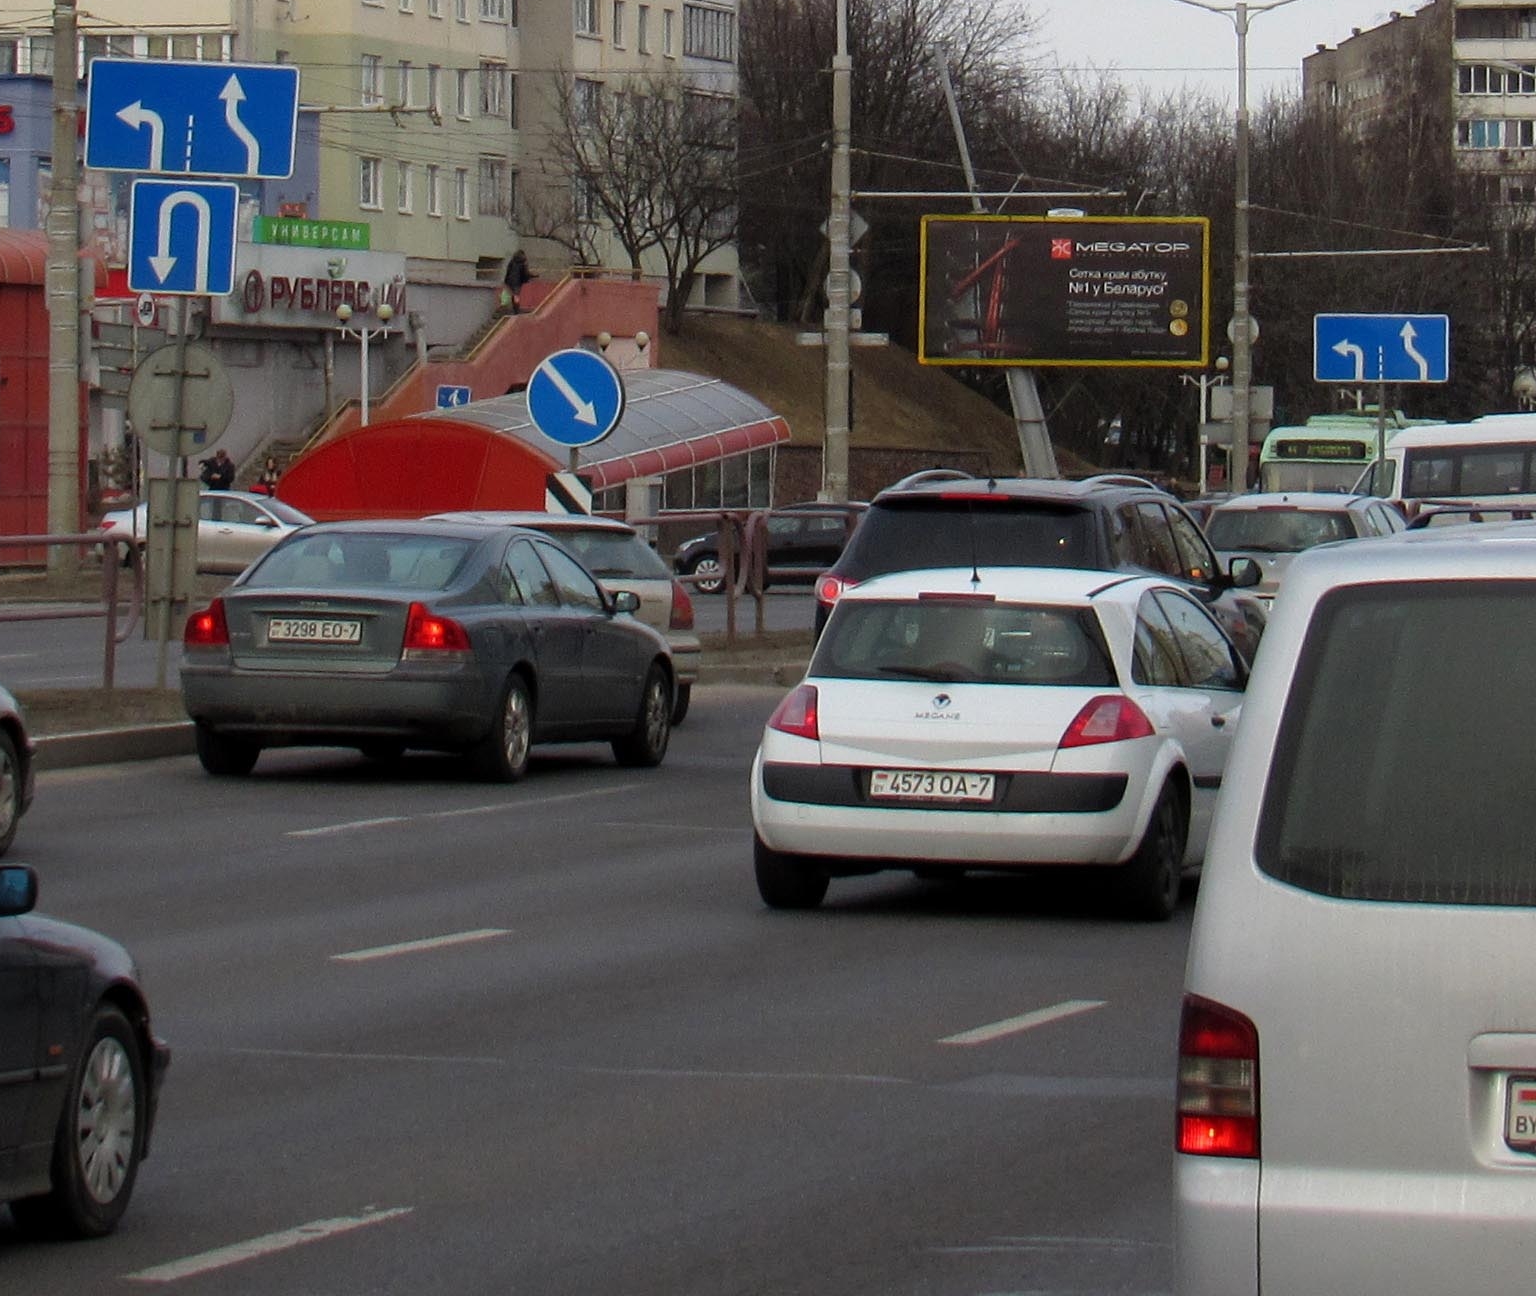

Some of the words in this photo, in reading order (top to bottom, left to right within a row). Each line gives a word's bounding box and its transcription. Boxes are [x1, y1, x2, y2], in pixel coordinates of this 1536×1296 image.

[270, 222, 363, 243] УНИВЕРСАМ
[1075, 241, 1192, 253] MEGATOP
[1068, 268, 1102, 280] Сетка
[1103, 271, 1130, 282] крам
[1131, 269, 1168, 282] абутку
[1068, 281, 1090, 295] №1
[1092, 285, 1101, 297] у
[283, 621, 317, 638] 3298
[321, 622, 358, 638] EO-7
[889, 772, 935, 794] 4573
[939, 775, 991, 796] OA-7
